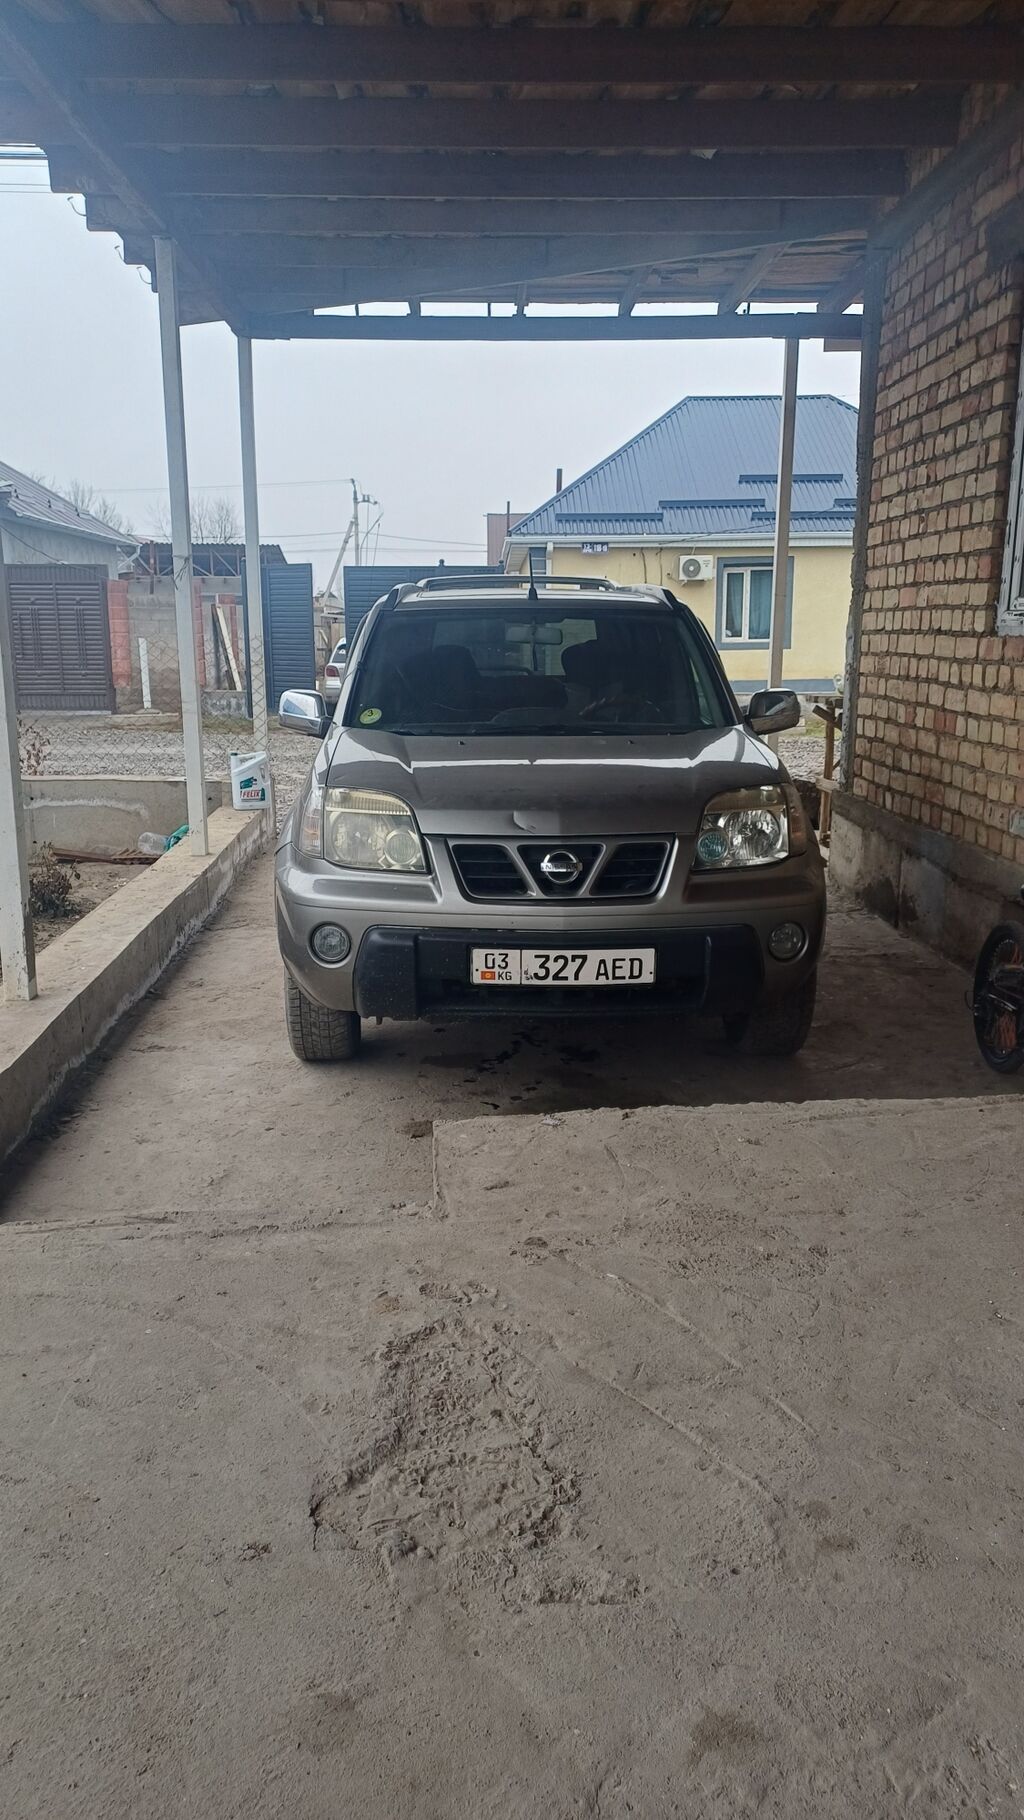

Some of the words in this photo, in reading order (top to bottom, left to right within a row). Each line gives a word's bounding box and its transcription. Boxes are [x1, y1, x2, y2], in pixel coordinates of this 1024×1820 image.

[484, 953, 509, 970] 03
[533, 954, 588, 981] 327
[595, 958, 643, 981] AED
[497, 971, 512, 981] KG
